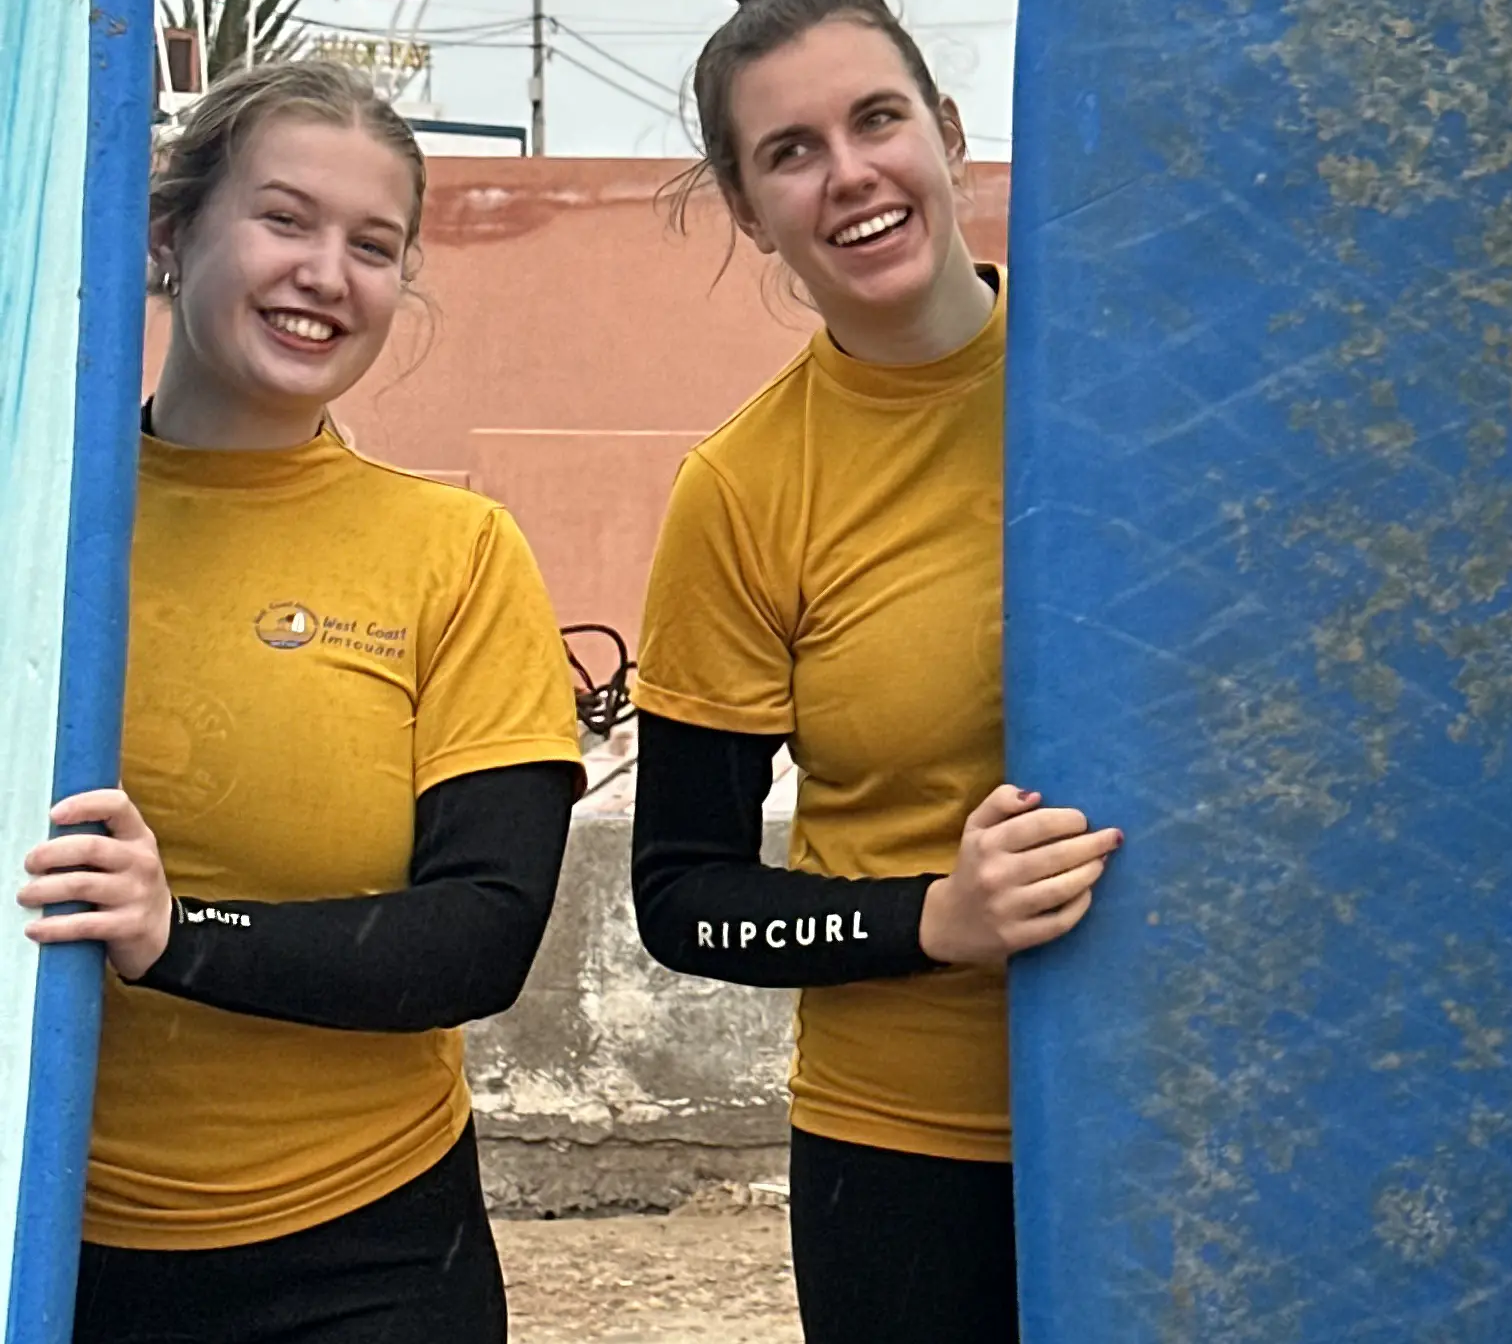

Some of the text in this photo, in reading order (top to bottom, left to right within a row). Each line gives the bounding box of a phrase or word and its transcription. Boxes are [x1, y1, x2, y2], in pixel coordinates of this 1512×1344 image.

[322, 615, 408, 641] West Coast
[697, 910, 869, 949] RIPCURL
